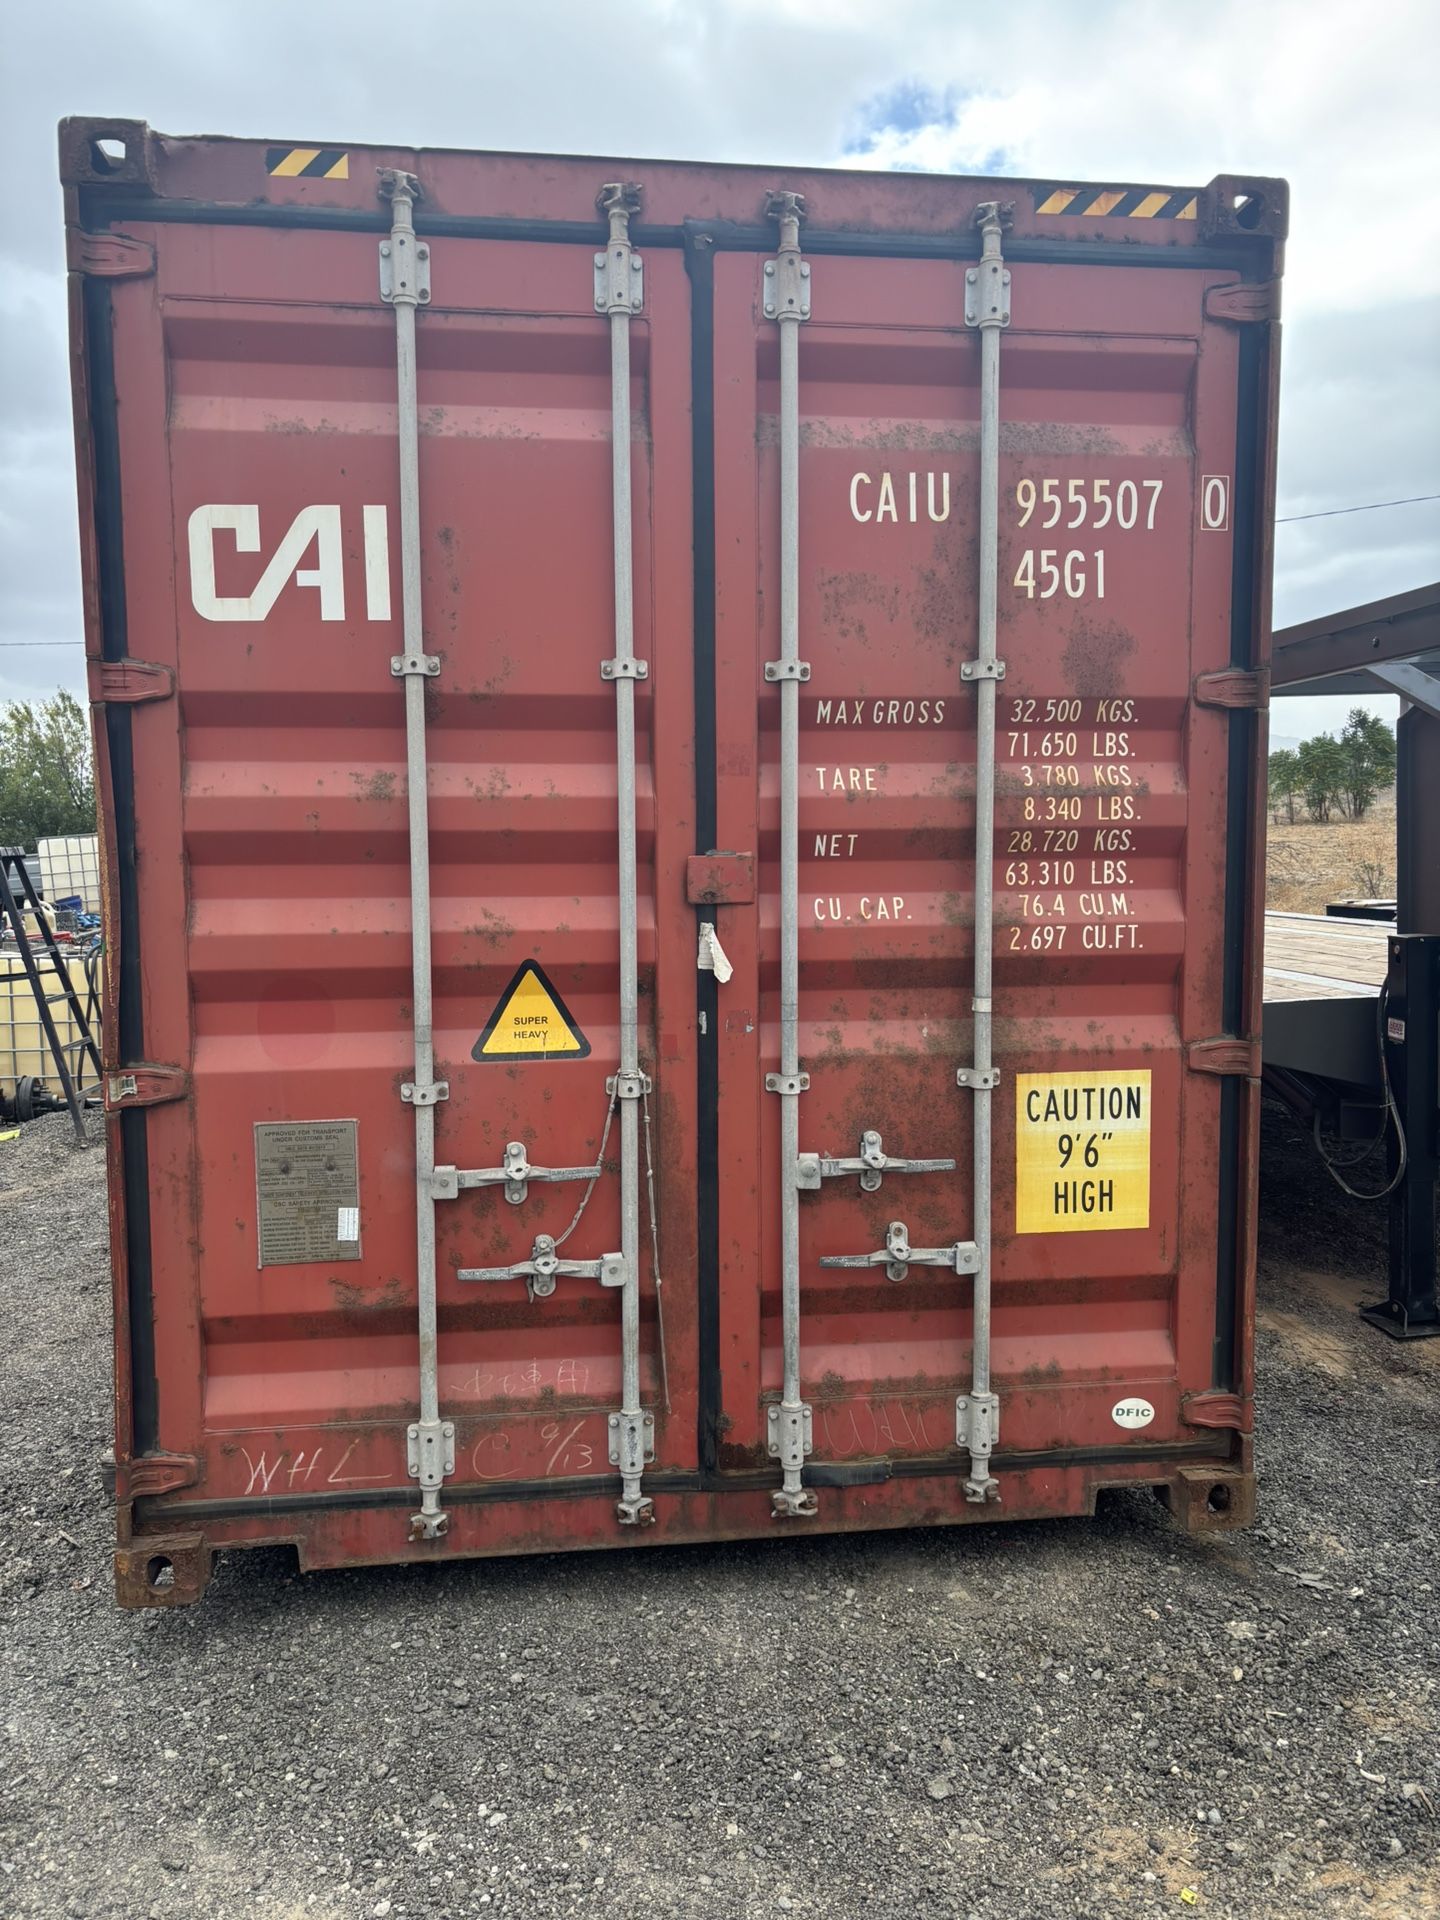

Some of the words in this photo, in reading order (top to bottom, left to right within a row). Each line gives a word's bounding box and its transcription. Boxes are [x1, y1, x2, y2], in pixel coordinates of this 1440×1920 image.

[850, 472, 949, 522] CAIU
[1017, 480, 1162, 529] 955507
[1204, 479, 1224, 528] 0
[188, 505, 391, 621] CAI
[1014, 550, 1104, 598] 45G1
[817, 701, 864, 723] MAX
[874, 701, 944, 723] GROSS
[1011, 700, 1081, 722] 32,500
[1097, 700, 1138, 722] KGS.
[1009, 733, 1076, 756] 71,650
[1094, 733, 1135, 756] LBS.
[816, 768, 876, 790] TARE
[1094, 765, 1138, 785] KGS.
[1025, 797, 1081, 820] 8,340
[1099, 796, 1140, 819] LBS.
[815, 835, 857, 856] NET
[1008, 830, 1078, 852] 28,720
[1094, 830, 1135, 850] KGS.
[1006, 862, 1074, 885] 63,310
[1092, 861, 1133, 884] LBS.
[815, 898, 850, 920] CU.
[861, 897, 911, 919] CAP.
[1019, 894, 1064, 916] 76.4
[1011, 926, 1066, 949] 2,697
[514, 1017, 547, 1025] SUPER
[514, 1031, 548, 1039] HEAVY
[1027, 1087, 1140, 1122] CAUTION
[1059, 1133, 1112, 1168] 9'6"
[1055, 1180, 1112, 1214] HIGH
[1116, 1408, 1150, 1417] DFIC
